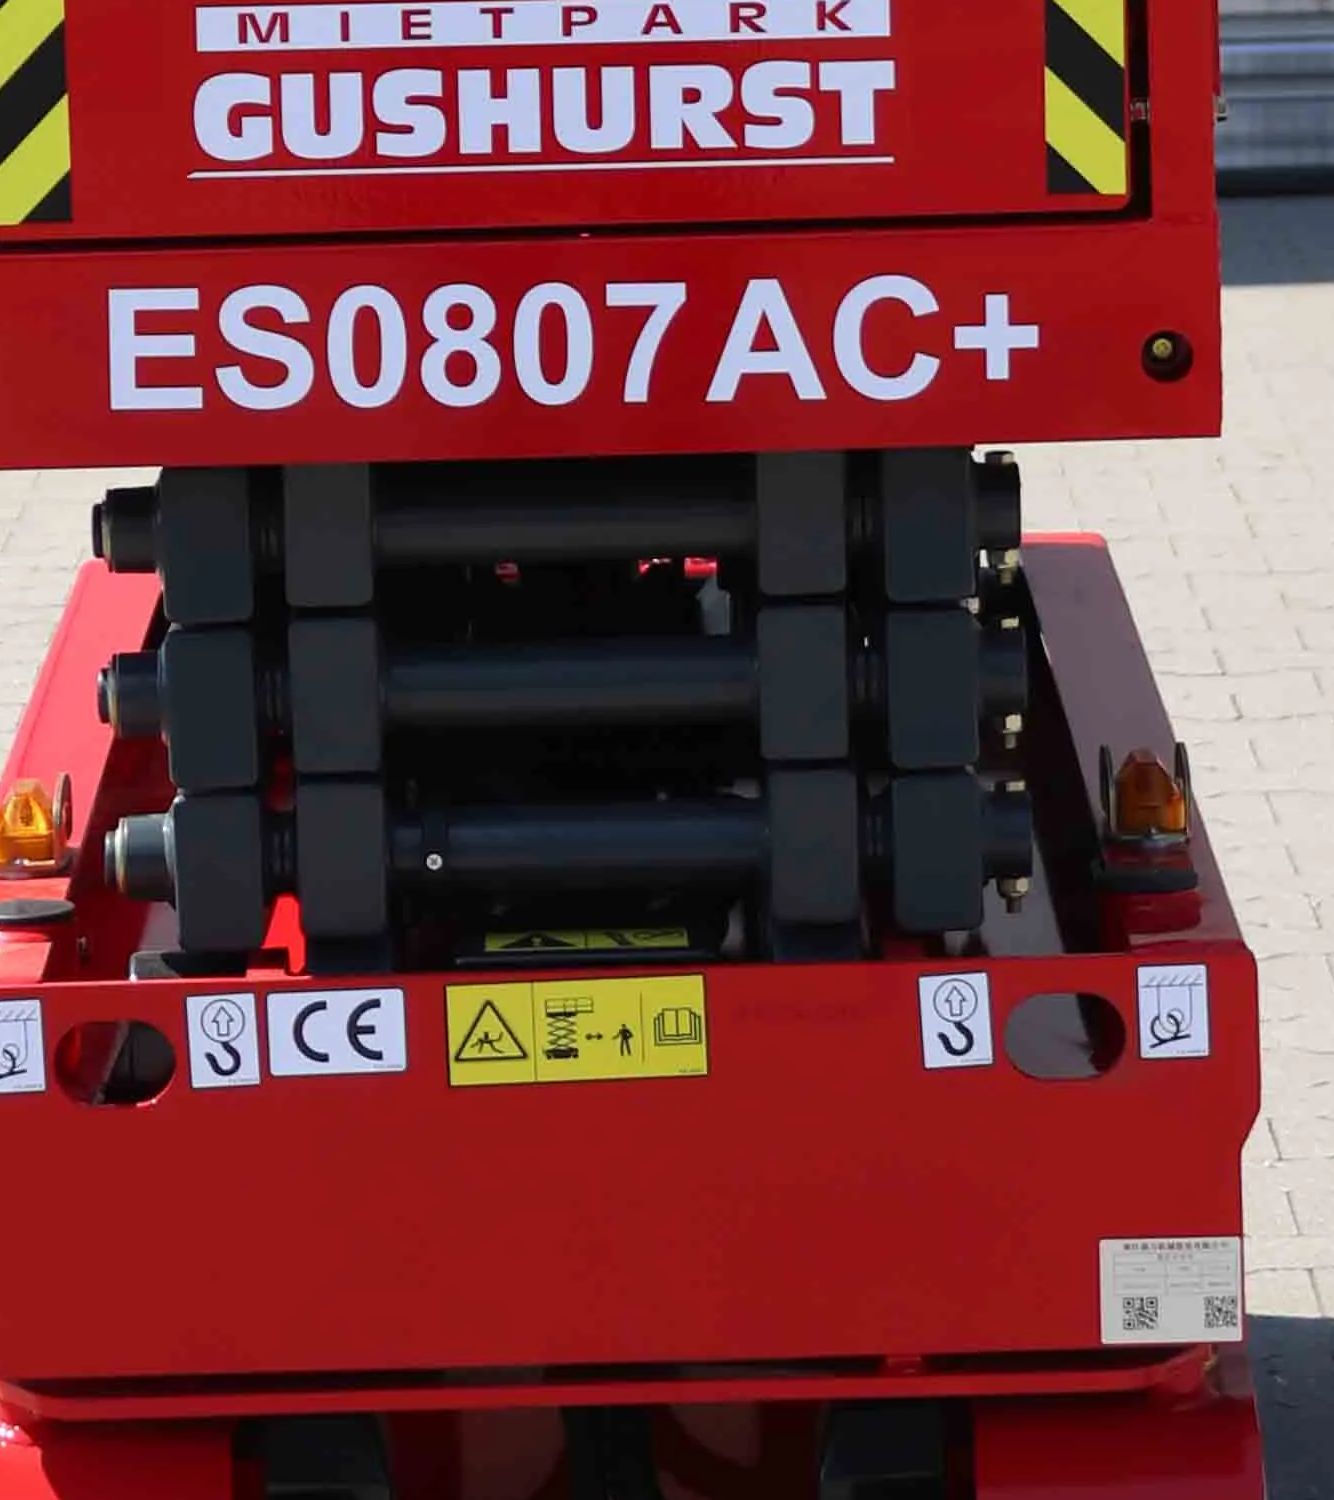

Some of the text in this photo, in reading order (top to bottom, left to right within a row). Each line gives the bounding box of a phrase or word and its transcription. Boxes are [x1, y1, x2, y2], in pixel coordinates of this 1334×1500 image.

[238, 0, 852, 44] MIETPARK
[193, 60, 896, 161] GUSHURST
[293, 999, 383, 1063] CE
